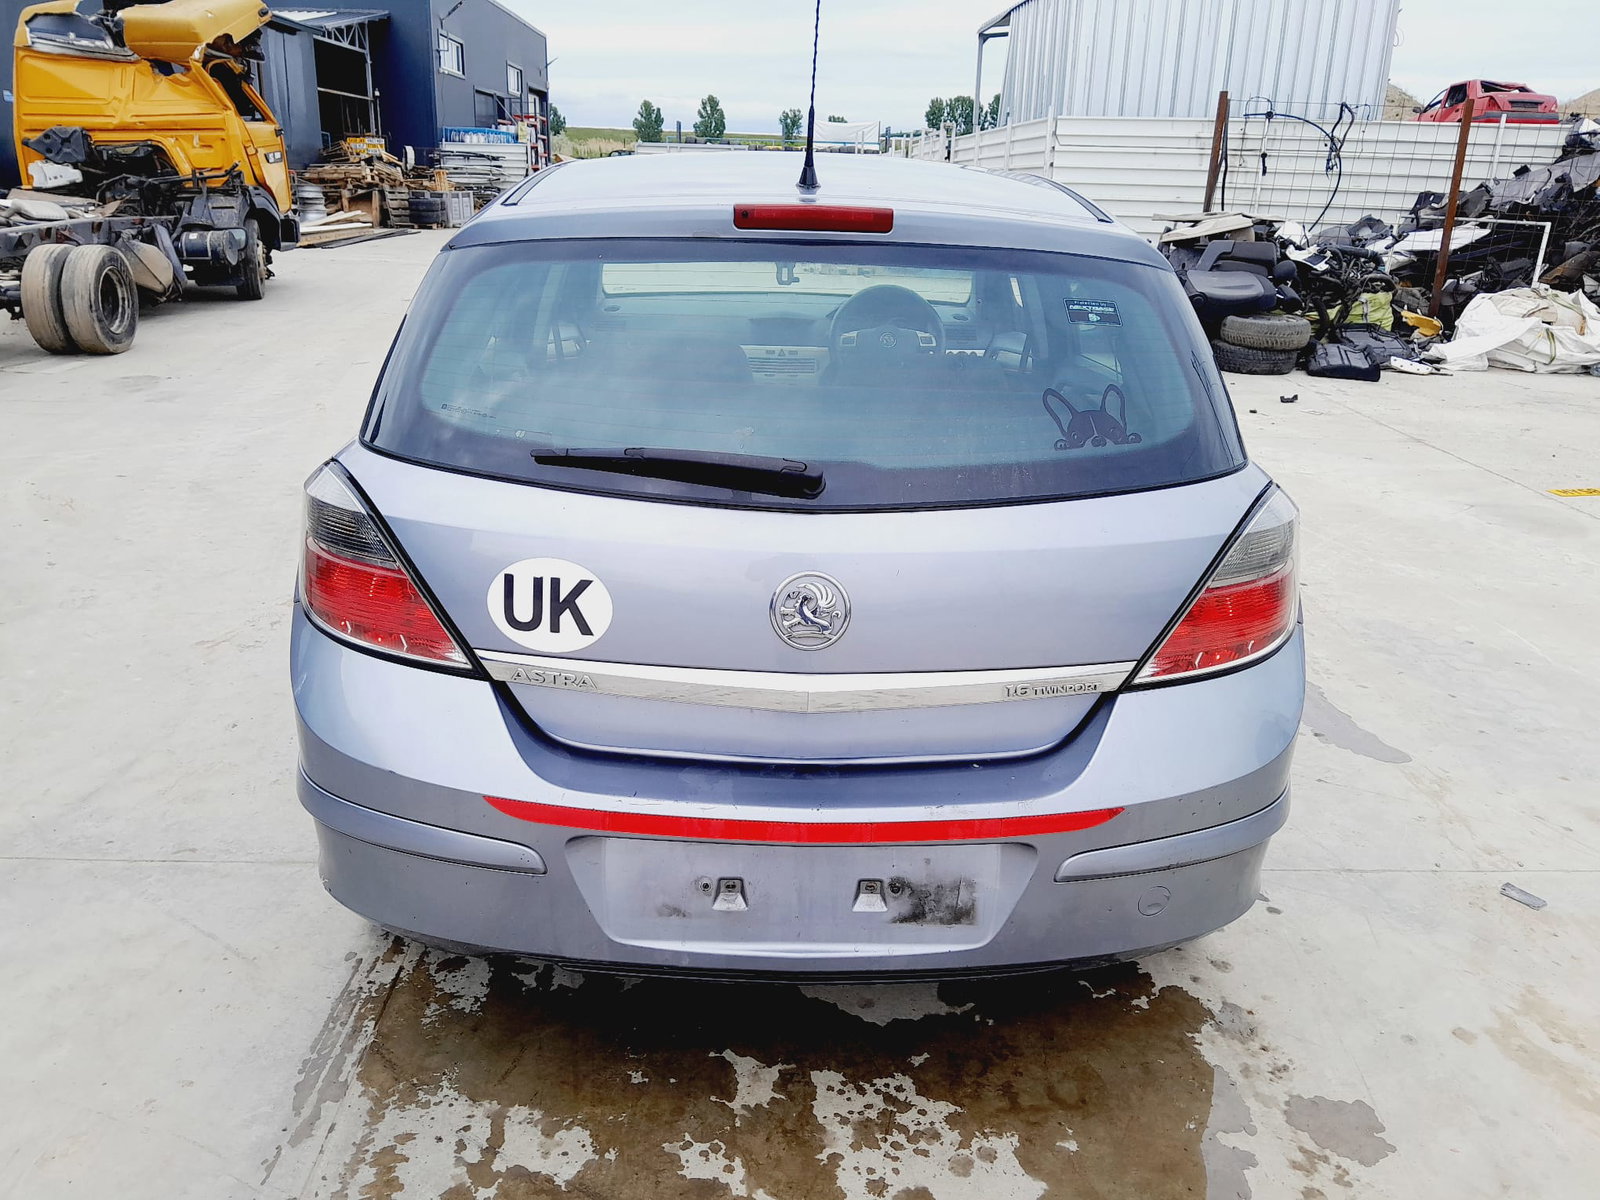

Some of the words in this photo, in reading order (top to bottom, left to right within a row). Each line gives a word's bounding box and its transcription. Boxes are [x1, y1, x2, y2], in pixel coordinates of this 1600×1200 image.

[503, 573, 595, 636] UK
[510, 667, 598, 690] ASTRA
[1032, 682, 1103, 696] TWINPORT
